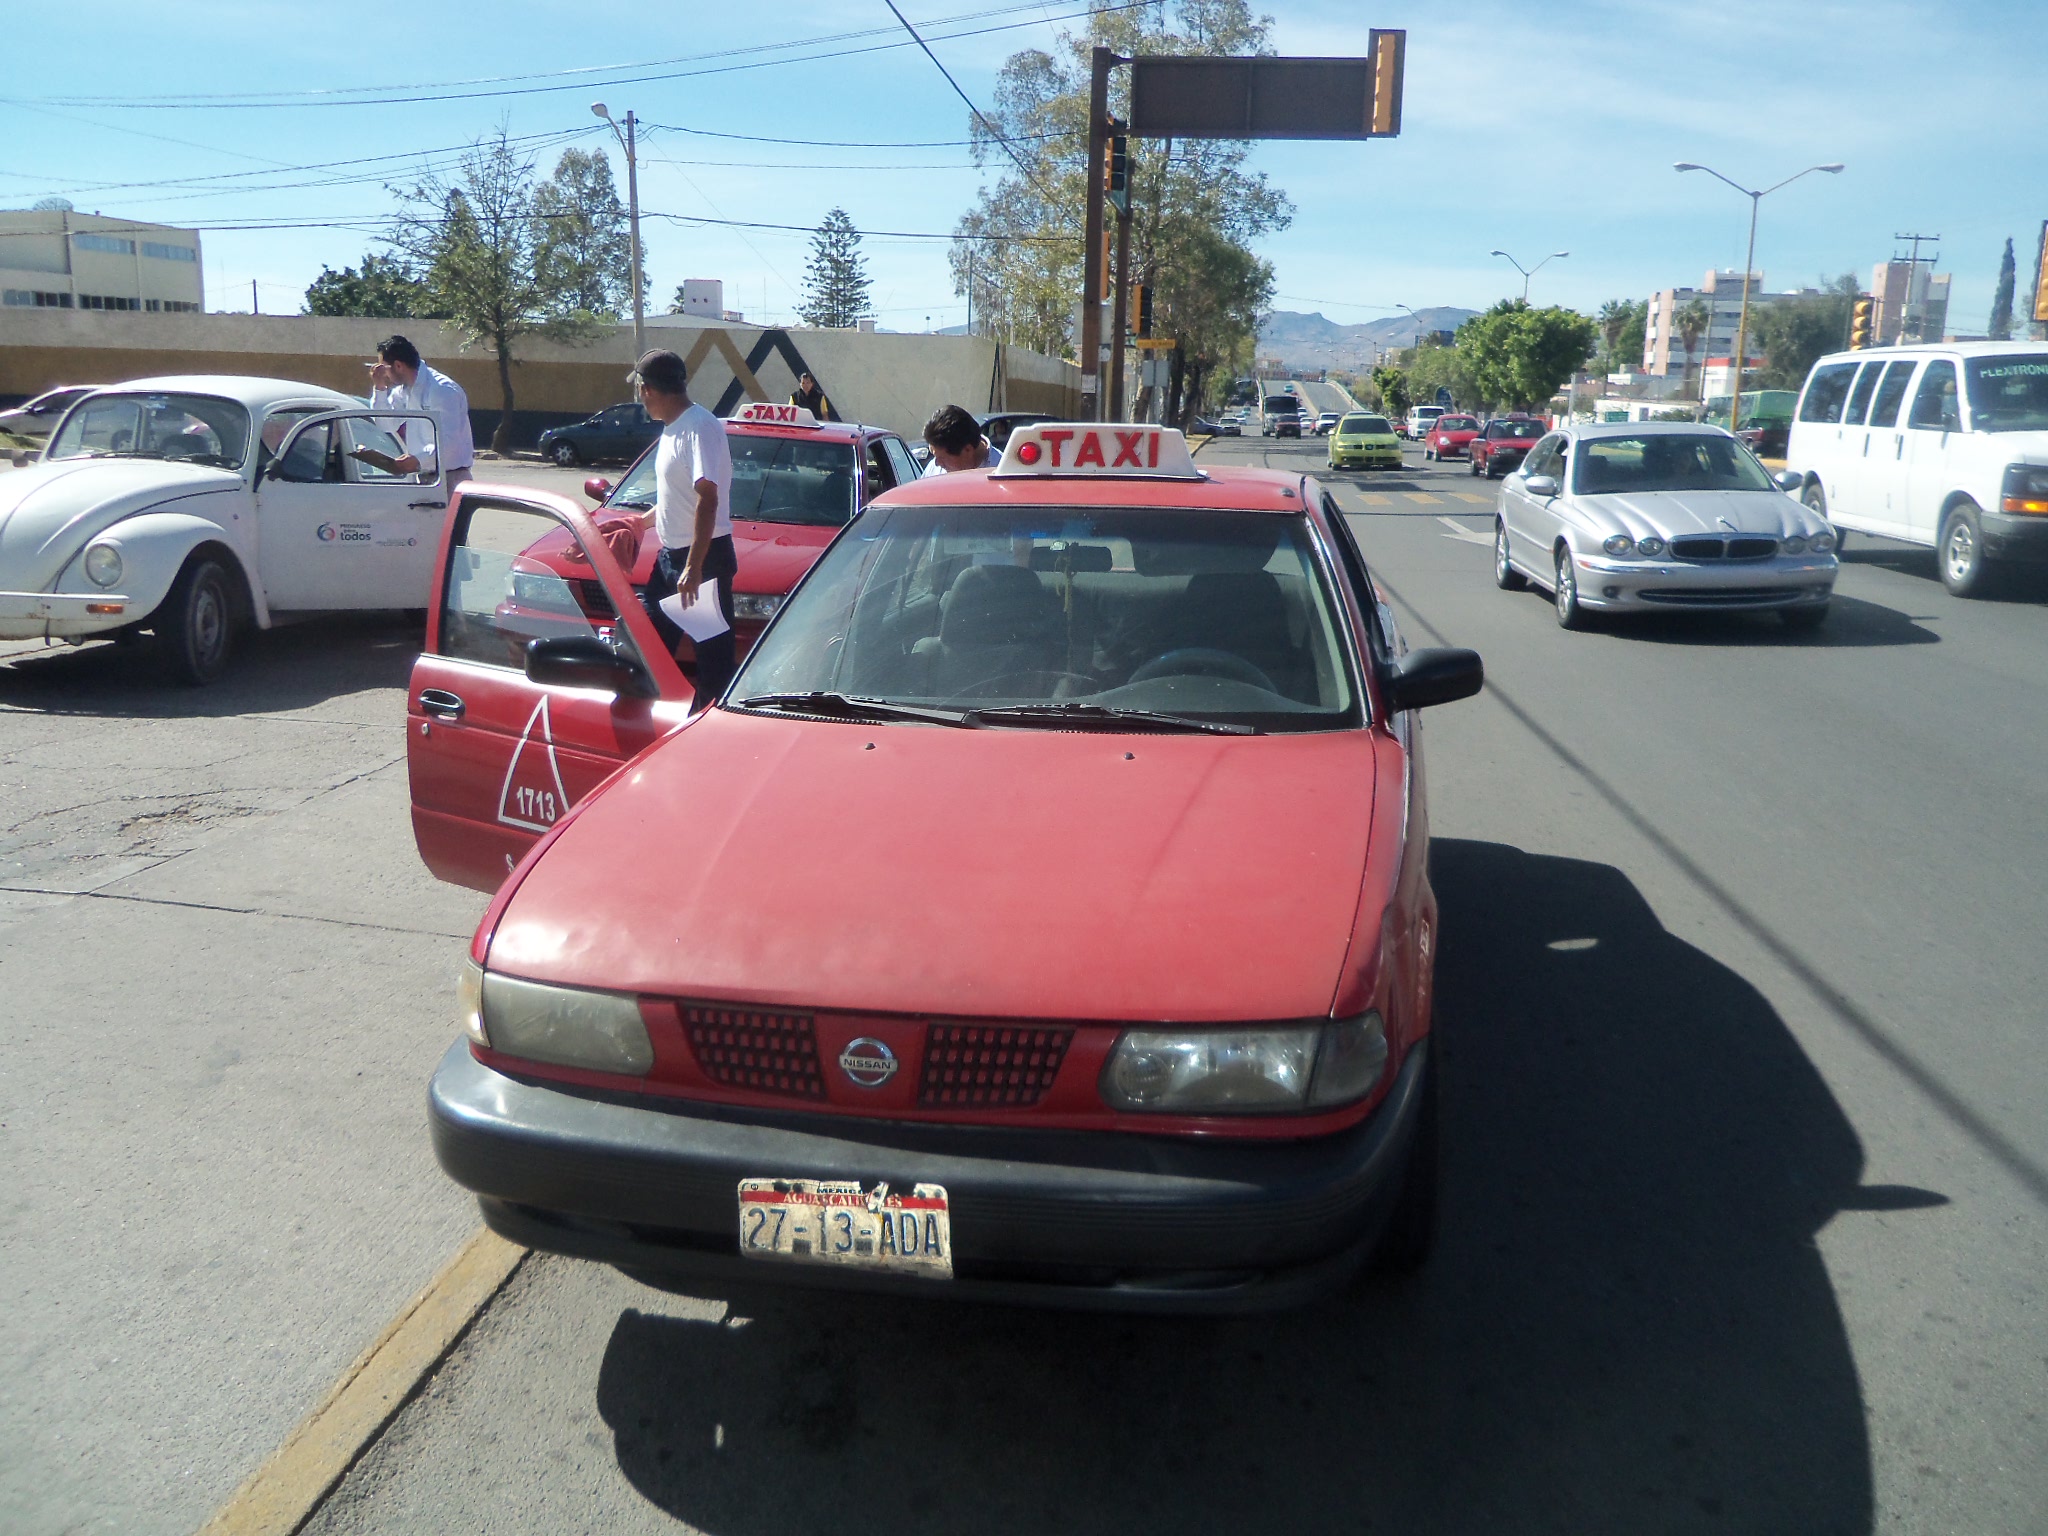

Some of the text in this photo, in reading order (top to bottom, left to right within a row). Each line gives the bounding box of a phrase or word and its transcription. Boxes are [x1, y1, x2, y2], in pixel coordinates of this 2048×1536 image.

[753, 404, 797, 422] TAXI
[1041, 430, 1160, 468] TAXI
[340, 532, 371, 541] todos
[516, 786, 556, 822] 1713
[843, 1058, 891, 1069] NISSAN
[748, 1207, 943, 1257] 27-13-ADA
